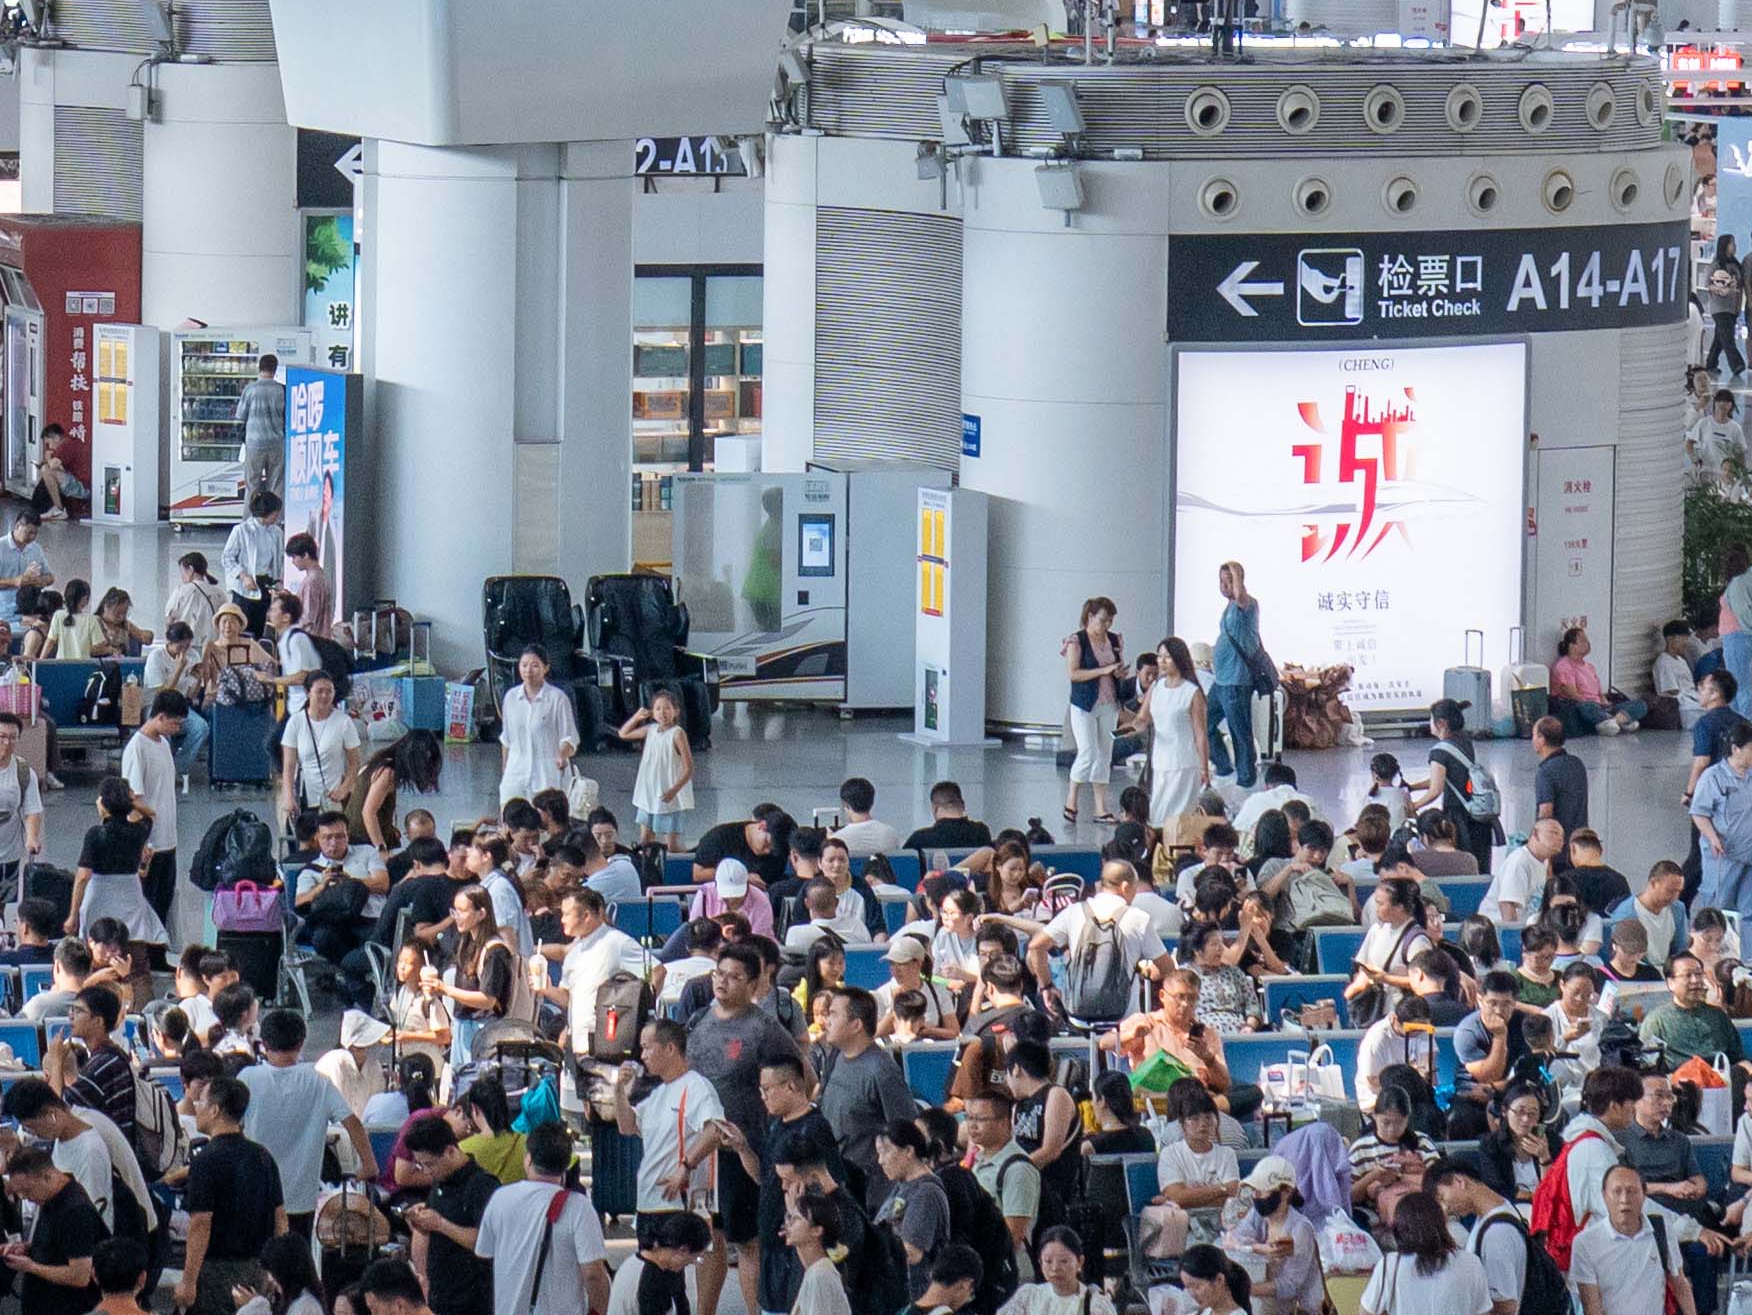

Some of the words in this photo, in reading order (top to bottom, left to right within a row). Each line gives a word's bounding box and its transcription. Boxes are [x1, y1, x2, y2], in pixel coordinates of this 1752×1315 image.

[1379, 253, 1484, 299] 检票口
[1507, 246, 1681, 312] A14-A17
[328, 303, 349, 327] 讲
[1378, 299, 1428, 319] Ticket
[1432, 298, 1481, 317] Check
[328, 344, 349, 368] 有
[1339, 357, 1395, 372] (CHENG)
[291, 380, 324, 433] 哈啰
[290, 430, 339, 484] 顺风车
[1563, 480, 1591, 494] 消火栓
[1317, 589, 1391, 611] 诚实守信
